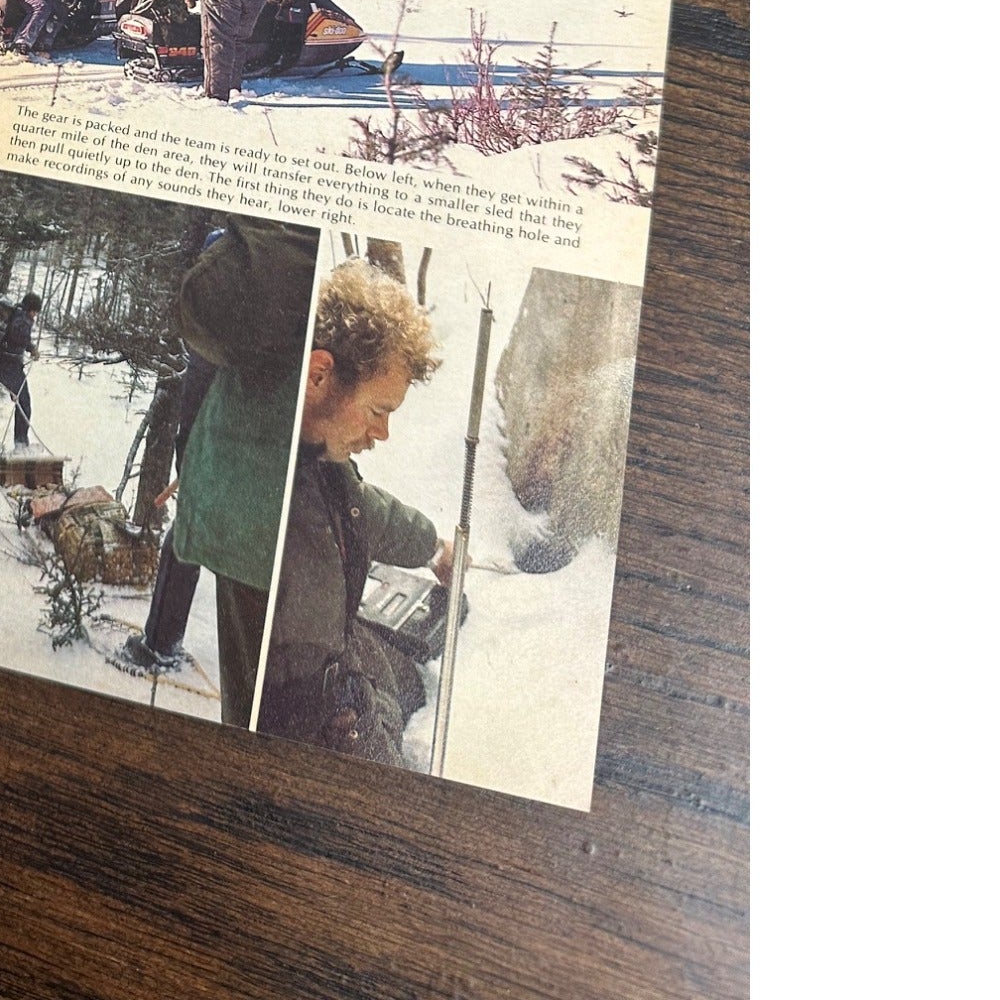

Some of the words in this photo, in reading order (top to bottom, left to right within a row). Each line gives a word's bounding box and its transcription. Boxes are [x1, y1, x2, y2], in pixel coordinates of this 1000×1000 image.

[7, 153, 39, 165] make
[44, 160, 108, 180] recordings
[113, 171, 127, 182] of
[130, 176, 153, 189] any
[158, 182, 201, 196] sounds
[207, 188, 234, 204] they
[240, 193, 271, 211] hear,
[279, 200, 316, 216] lower
[321, 206, 356, 226] right.
[10, 135, 36, 149] then
[40, 143, 64, 154] pull
[68, 149, 111, 165] quietly
[116, 157, 131, 169] up
[136, 160, 147, 170] to
[151, 159, 172, 175] the
[175, 164, 203, 182] den.
[209, 172, 232, 186] The
[237, 176, 260, 191] first
[265, 182, 298, 200] thing
[303, 189, 331, 205] they
[336, 195, 353, 207] do
[358, 201, 368, 210] is
[374, 200, 415, 219] locate
[420, 209, 441, 223] the
[447, 213, 513, 239] breathing
[519, 226, 549, 242] hole
[554, 237, 580, 248] and
[13, 123, 57, 137] quarter
[61, 131, 88, 143] mile
[93, 136, 107, 146] of
[111, 138, 129, 151] the
[135, 143, 157, 156] den
[163, 151, 193, 164] area,
[200, 154, 227, 171] they
[233, 162, 257, 174] will
[263, 167, 312, 183] transfer
[317, 178, 389, 200] everything
[395, 190, 408, 200] to
[414, 195, 421, 203] a
[428, 197, 479, 212] smaller
[485, 204, 513, 219] sled
[520, 210, 546, 225] that
[553, 216, 581, 233] they
[17, 104, 39, 119] The
[42, 111, 68, 125] gear
[72, 114, 82, 126] is
[84, 117, 130, 136] packed
[134, 130, 157, 140] and
[162, 132, 181, 145] the
[185, 137, 215, 151] team
[221, 145, 230, 153] is
[235, 147, 270, 163] ready
[275, 153, 287, 163] to
[292, 158, 309, 167] set
[314, 162, 339, 173] out.
[345, 163, 387, 180] Below
[392, 171, 417, 188] left,
[423, 179, 460, 193] when
[466, 184, 495, 201] they
[500, 193, 521, 204] get
[527, 198, 570, 212] within
